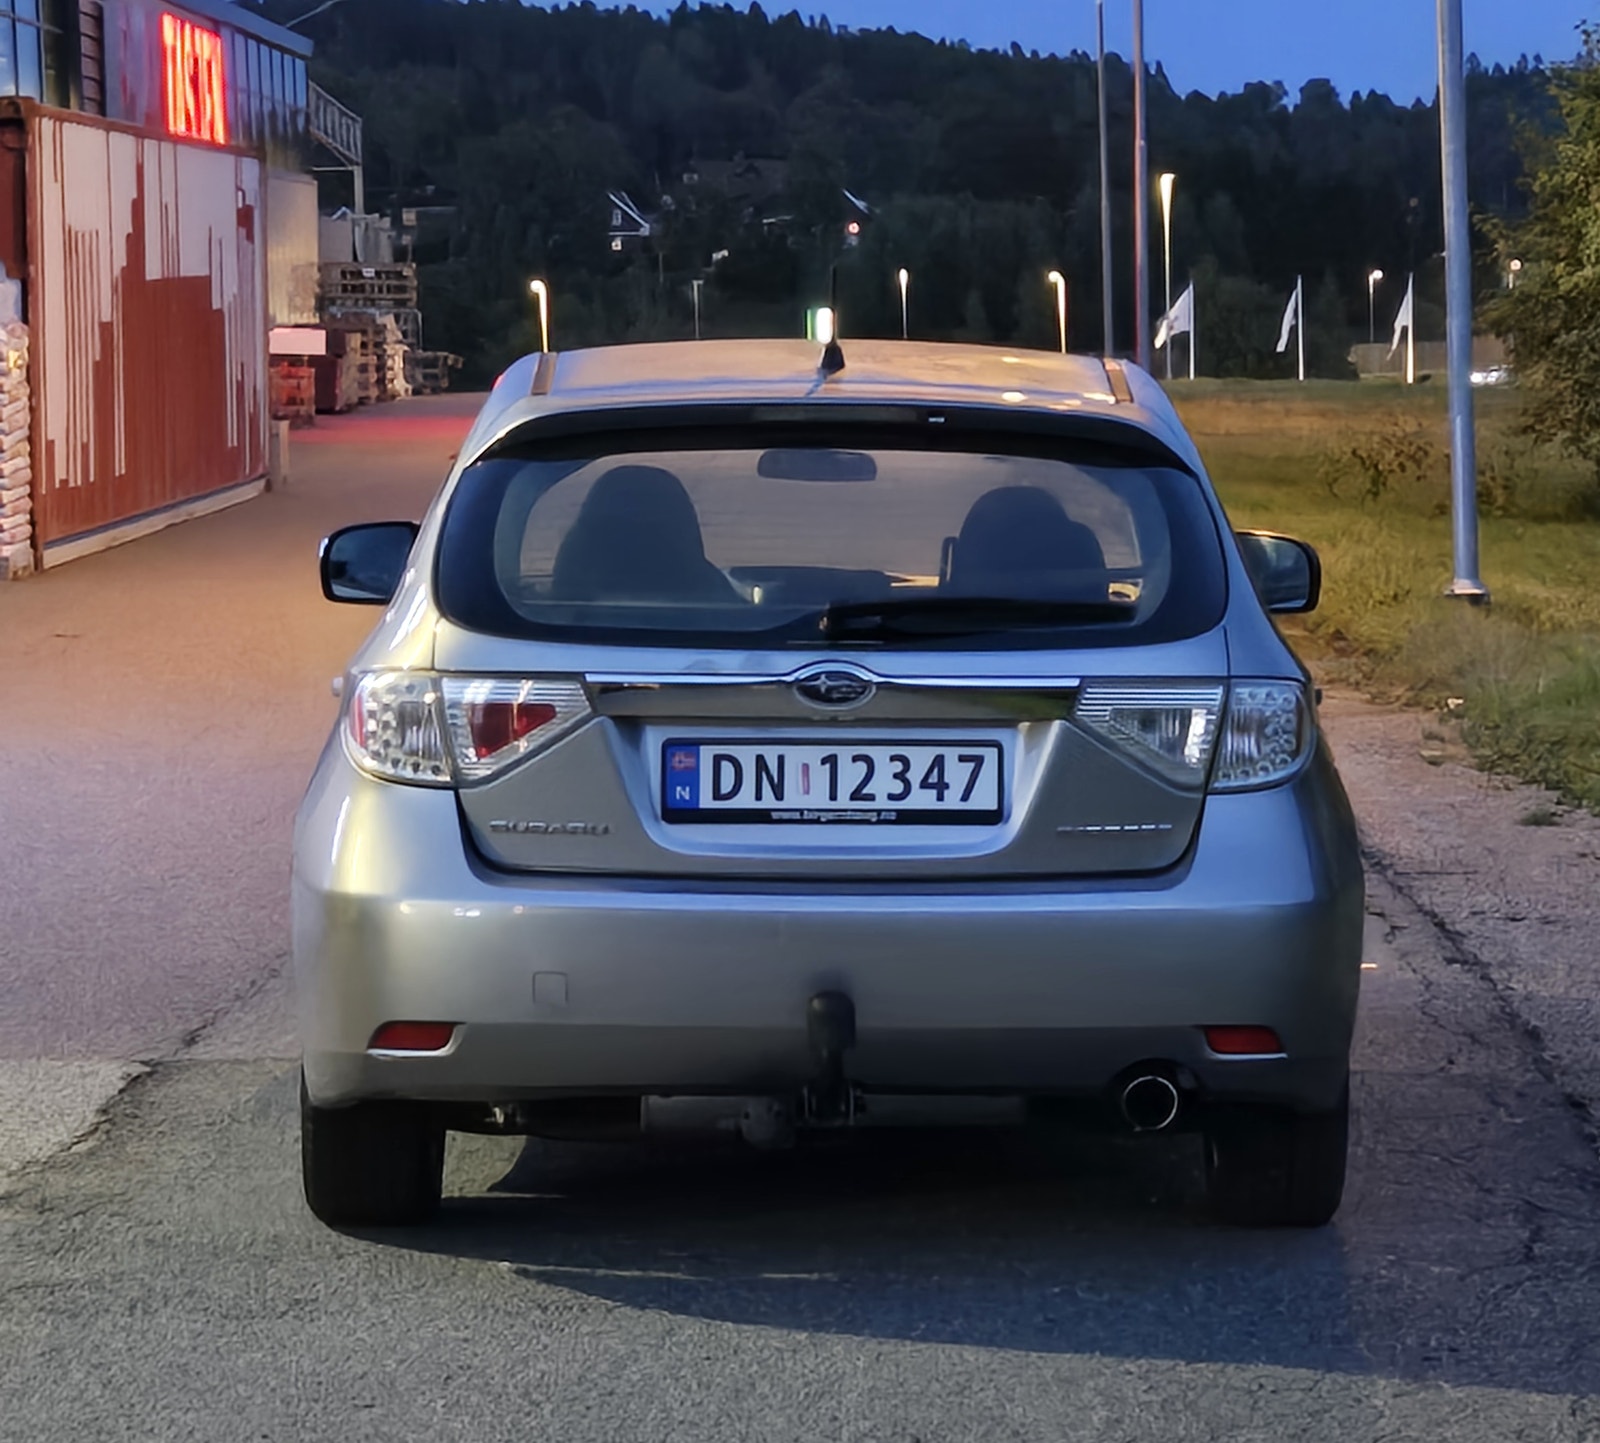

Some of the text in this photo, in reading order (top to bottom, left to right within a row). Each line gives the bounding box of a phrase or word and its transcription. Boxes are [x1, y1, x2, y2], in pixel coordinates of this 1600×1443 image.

[675, 785, 691, 801] N
[711, 753, 986, 802] DN 12347
